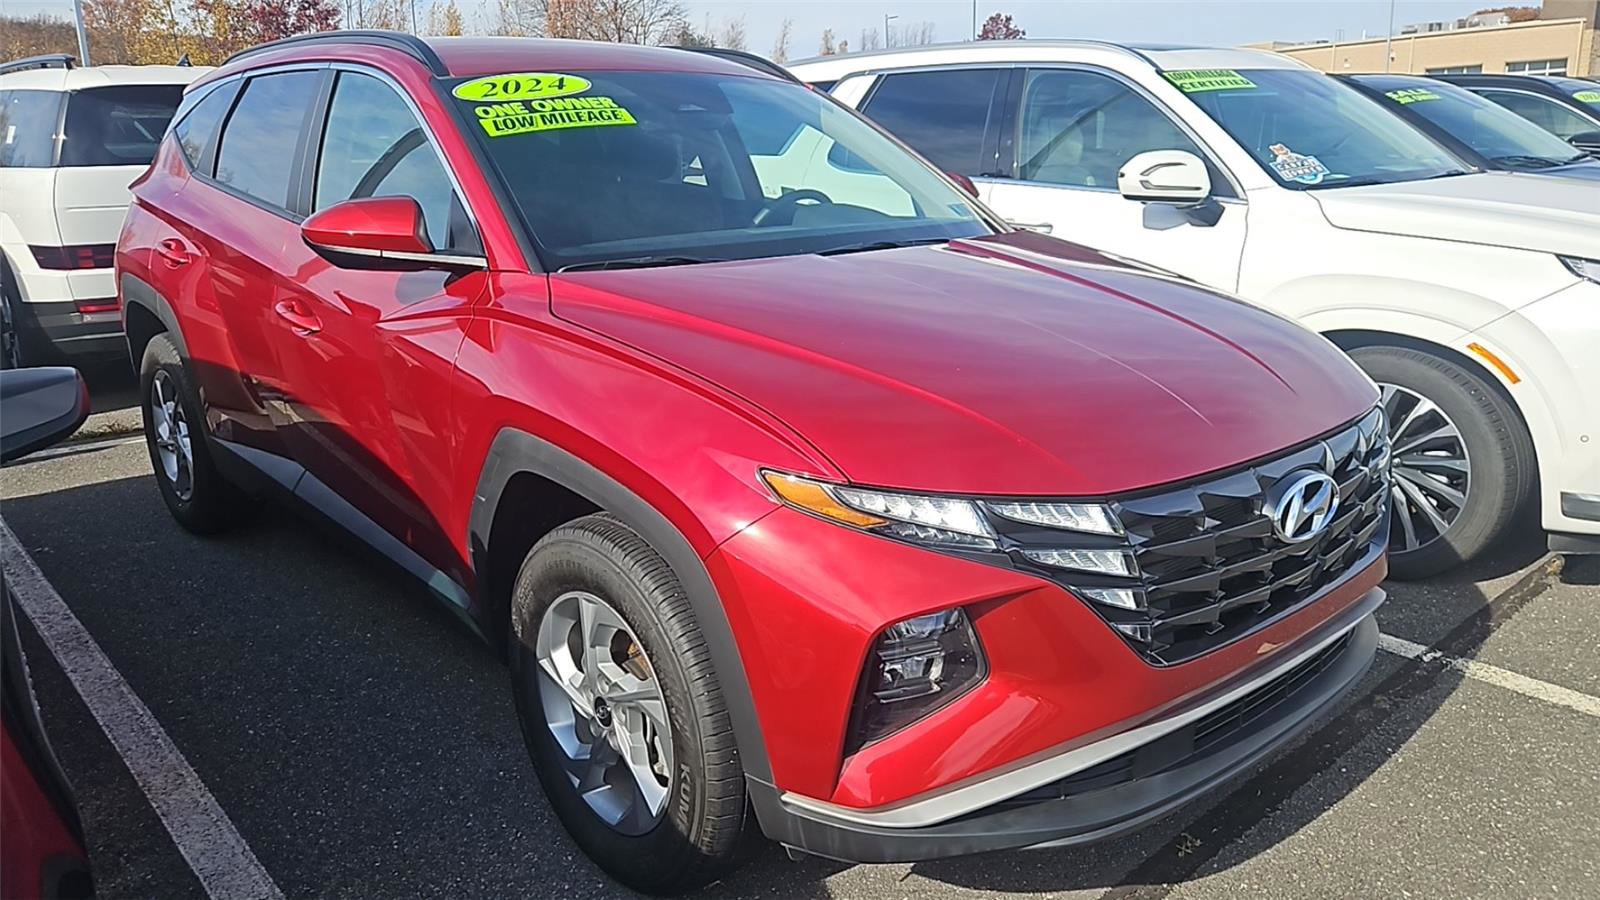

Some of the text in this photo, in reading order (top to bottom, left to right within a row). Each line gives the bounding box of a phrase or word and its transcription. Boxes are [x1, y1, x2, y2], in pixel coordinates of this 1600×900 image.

[481, 77, 566, 98] 2024
[1181, 79, 1250, 90] CERTIFIED
[475, 97, 619, 120] ONE OWNER
[493, 109, 622, 131] LOW MILEAGE
